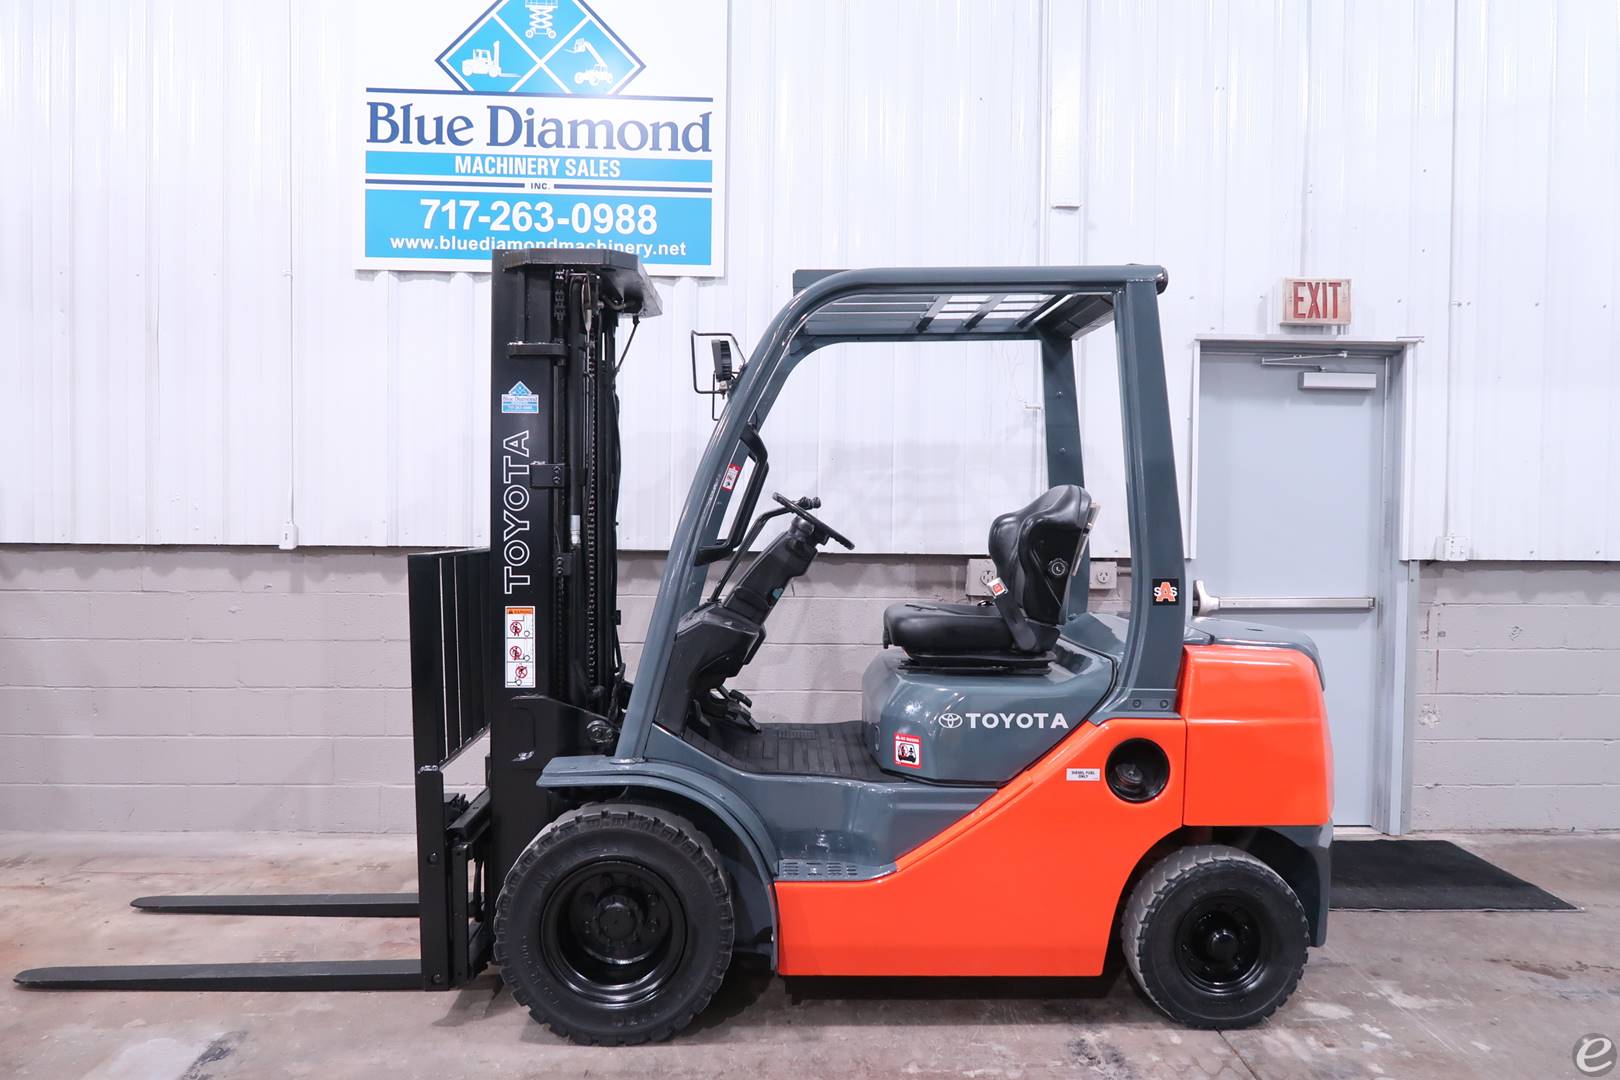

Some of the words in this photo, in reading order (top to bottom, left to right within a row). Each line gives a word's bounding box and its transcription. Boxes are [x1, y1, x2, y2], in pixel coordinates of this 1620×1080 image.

[366, 101, 474, 147] Blue
[486, 105, 712, 152] Diamond
[455, 155, 559, 178] MACHINERY
[564, 158, 621, 178] SALES
[530, 182, 551, 191] INC.
[419, 199, 658, 235] 717-263-0988
[390, 235, 687, 257] www.bluediamondmachinery.net
[1293, 281, 1342, 320] EXIT
[503, 430, 530, 595] TOYOTA
[1153, 581, 1178, 602] SAS
[965, 712, 1069, 729] TOYOTA
